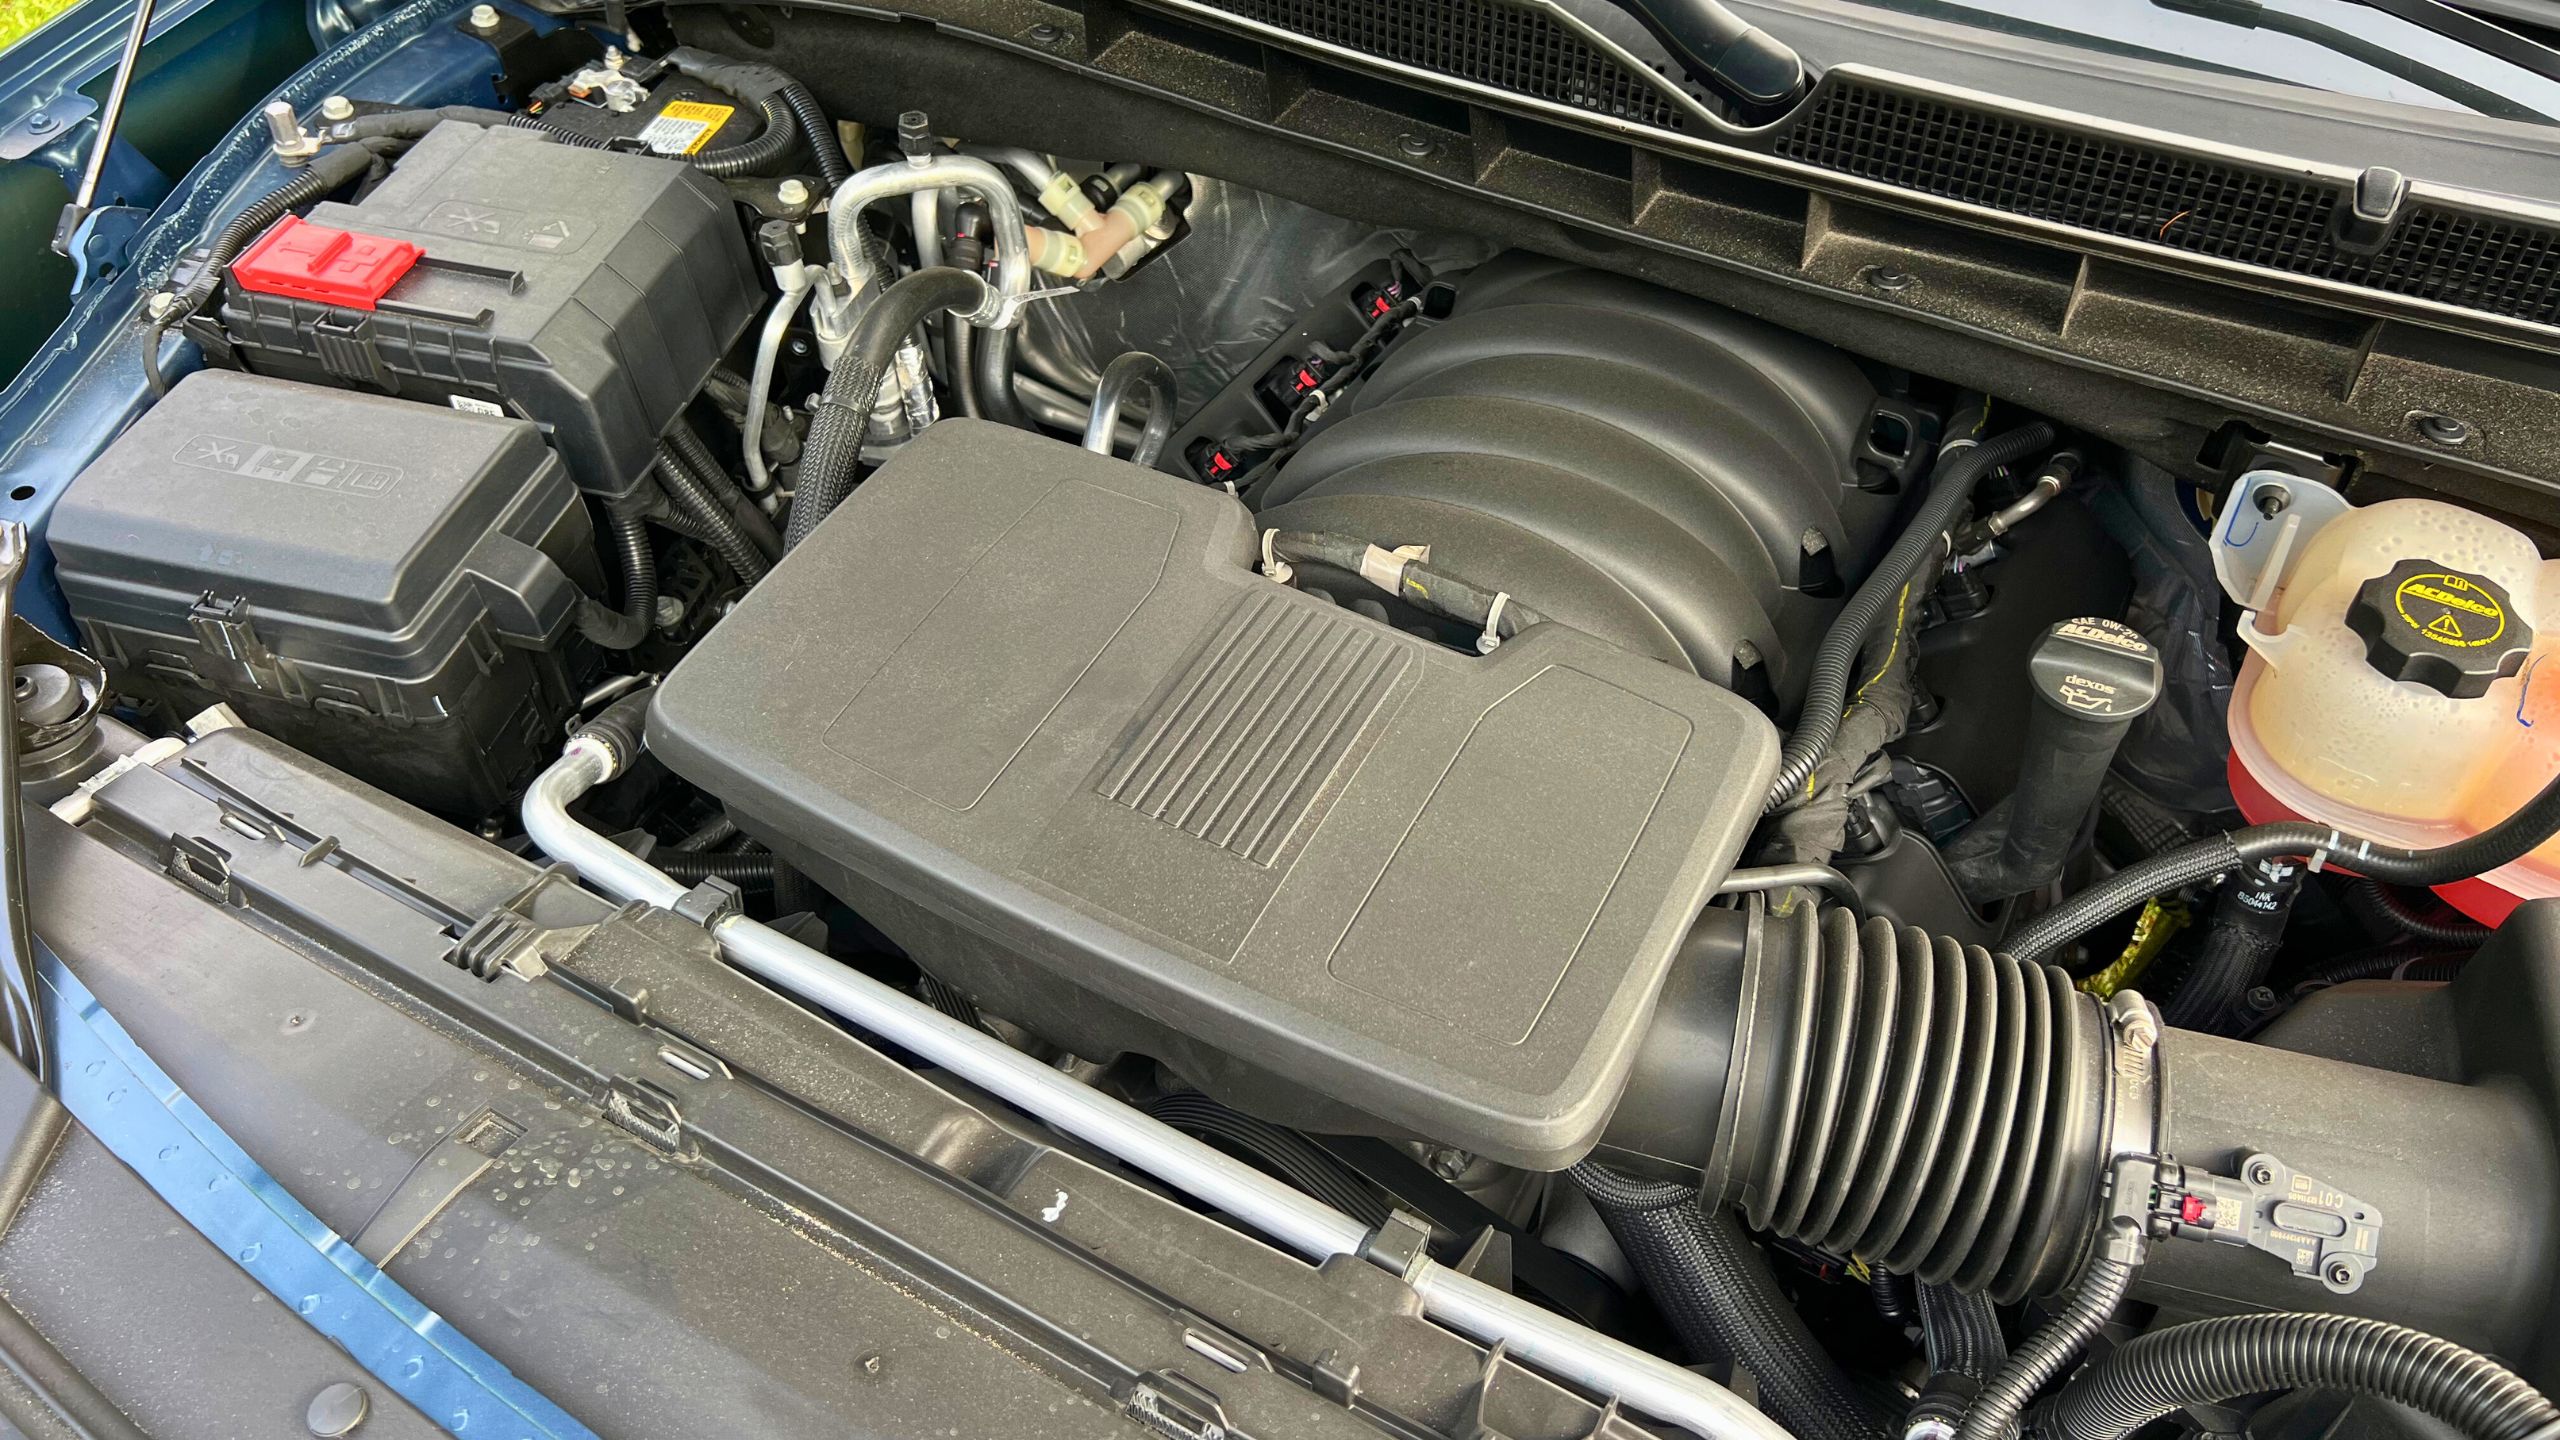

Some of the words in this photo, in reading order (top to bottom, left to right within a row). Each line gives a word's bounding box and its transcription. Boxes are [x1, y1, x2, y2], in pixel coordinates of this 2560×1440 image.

[2405, 583, 2499, 617] ACDelco
[2071, 617, 2096, 626] SAE
[2058, 623, 2148, 653] ACDelco
[2065, 675, 2116, 695] dexos
